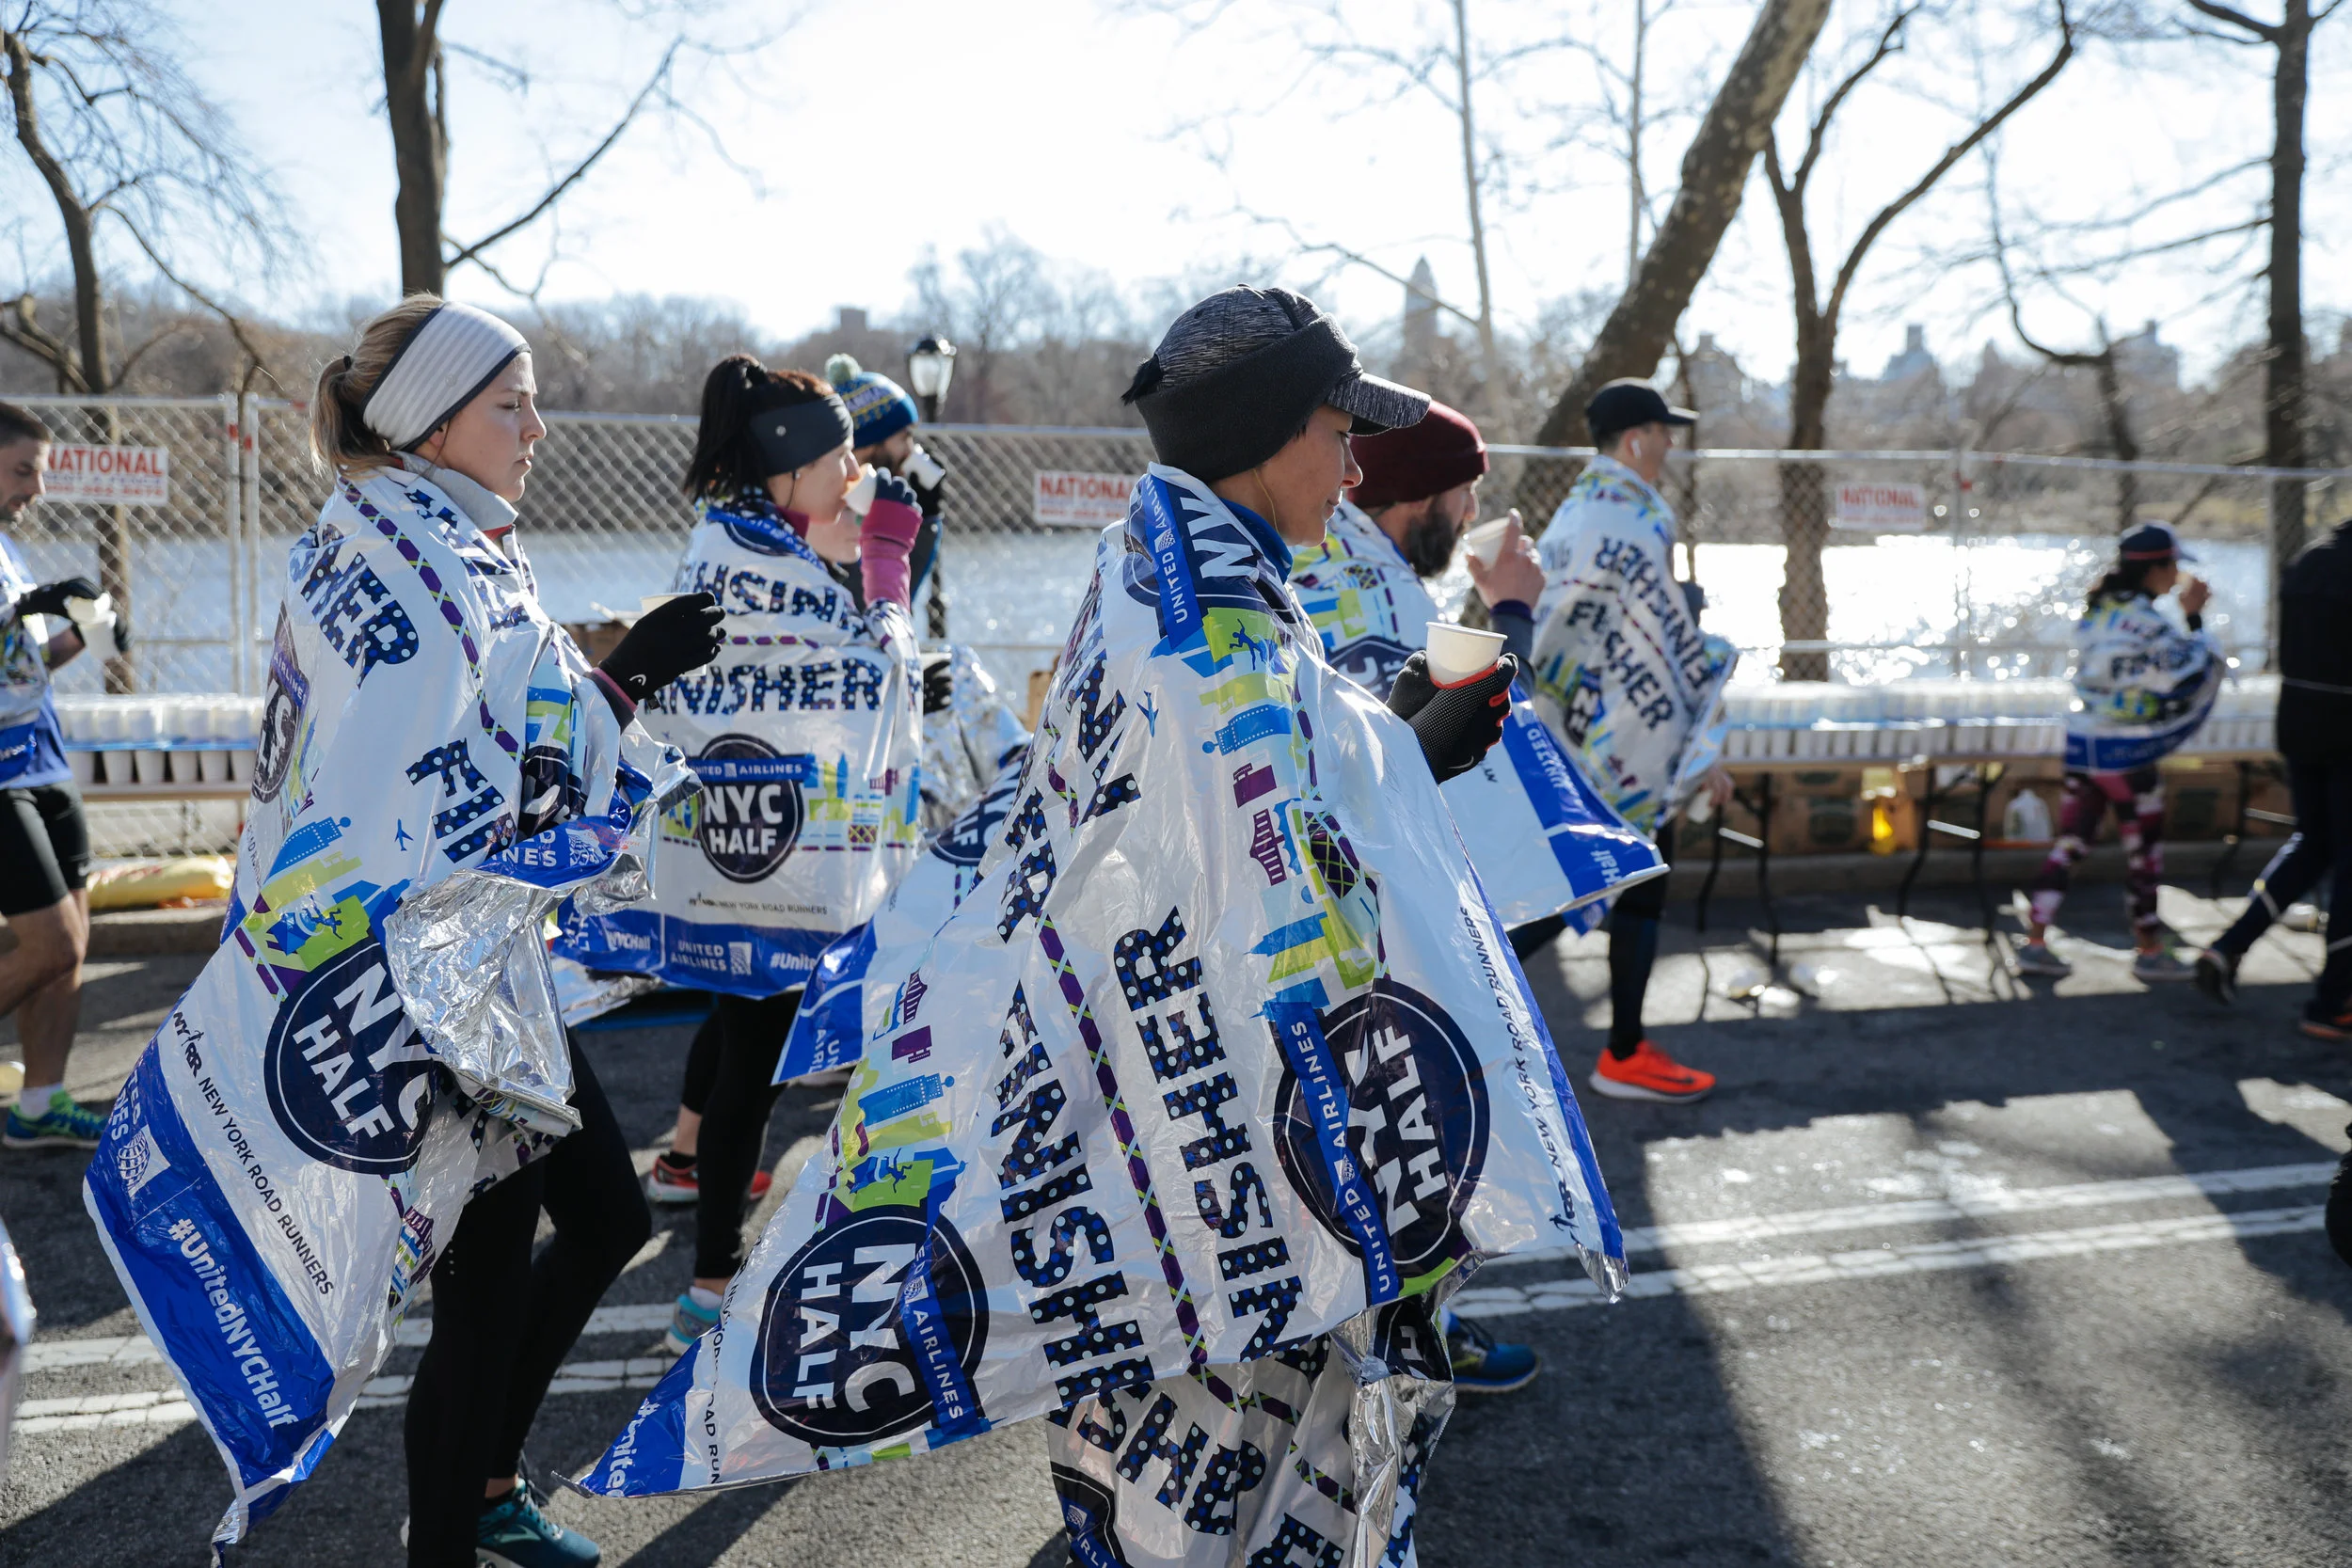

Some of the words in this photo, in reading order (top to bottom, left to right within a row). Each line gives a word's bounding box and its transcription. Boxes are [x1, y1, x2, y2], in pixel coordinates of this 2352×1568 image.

[1040, 475, 1132, 499] NATIONA
[1162, 551, 1189, 624] UNITED
[705, 784, 783, 825] NYC
[739, 763, 803, 775] AIRLINES
[708, 828, 777, 855] HALF
[739, 902, 759, 911] YORK
[762, 904, 787, 912] ROAD
[787, 905, 828, 915] RUNNERS
[670, 950, 727, 972] AIRLINES
[677, 940, 724, 956] UNITED
[1459, 906, 1501, 990] RUNNERS
[1498, 996, 1524, 1052] ROAD
[293, 1014, 395, 1138] HALF
[1290, 1021, 1347, 1148] AIRLINES
[1372, 1025, 1447, 1200] HALF
[1517, 1056, 1540, 1112] YORK
[1534, 1118, 1562, 1168] NEW
[199, 1077, 229, 1117] NEW
[222, 1117, 255, 1165] YORK
[247, 1164, 284, 1213] ROAD
[277, 1213, 334, 1296] RUNNERS
[1343, 1187, 1391, 1293] UNITED
[167, 1218, 299, 1429] #UnitedNYCHalf
[792, 1261, 844, 1410] HALF
[844, 1243, 917, 1413] NYC
[913, 1309, 964, 1419] AIRLINES
